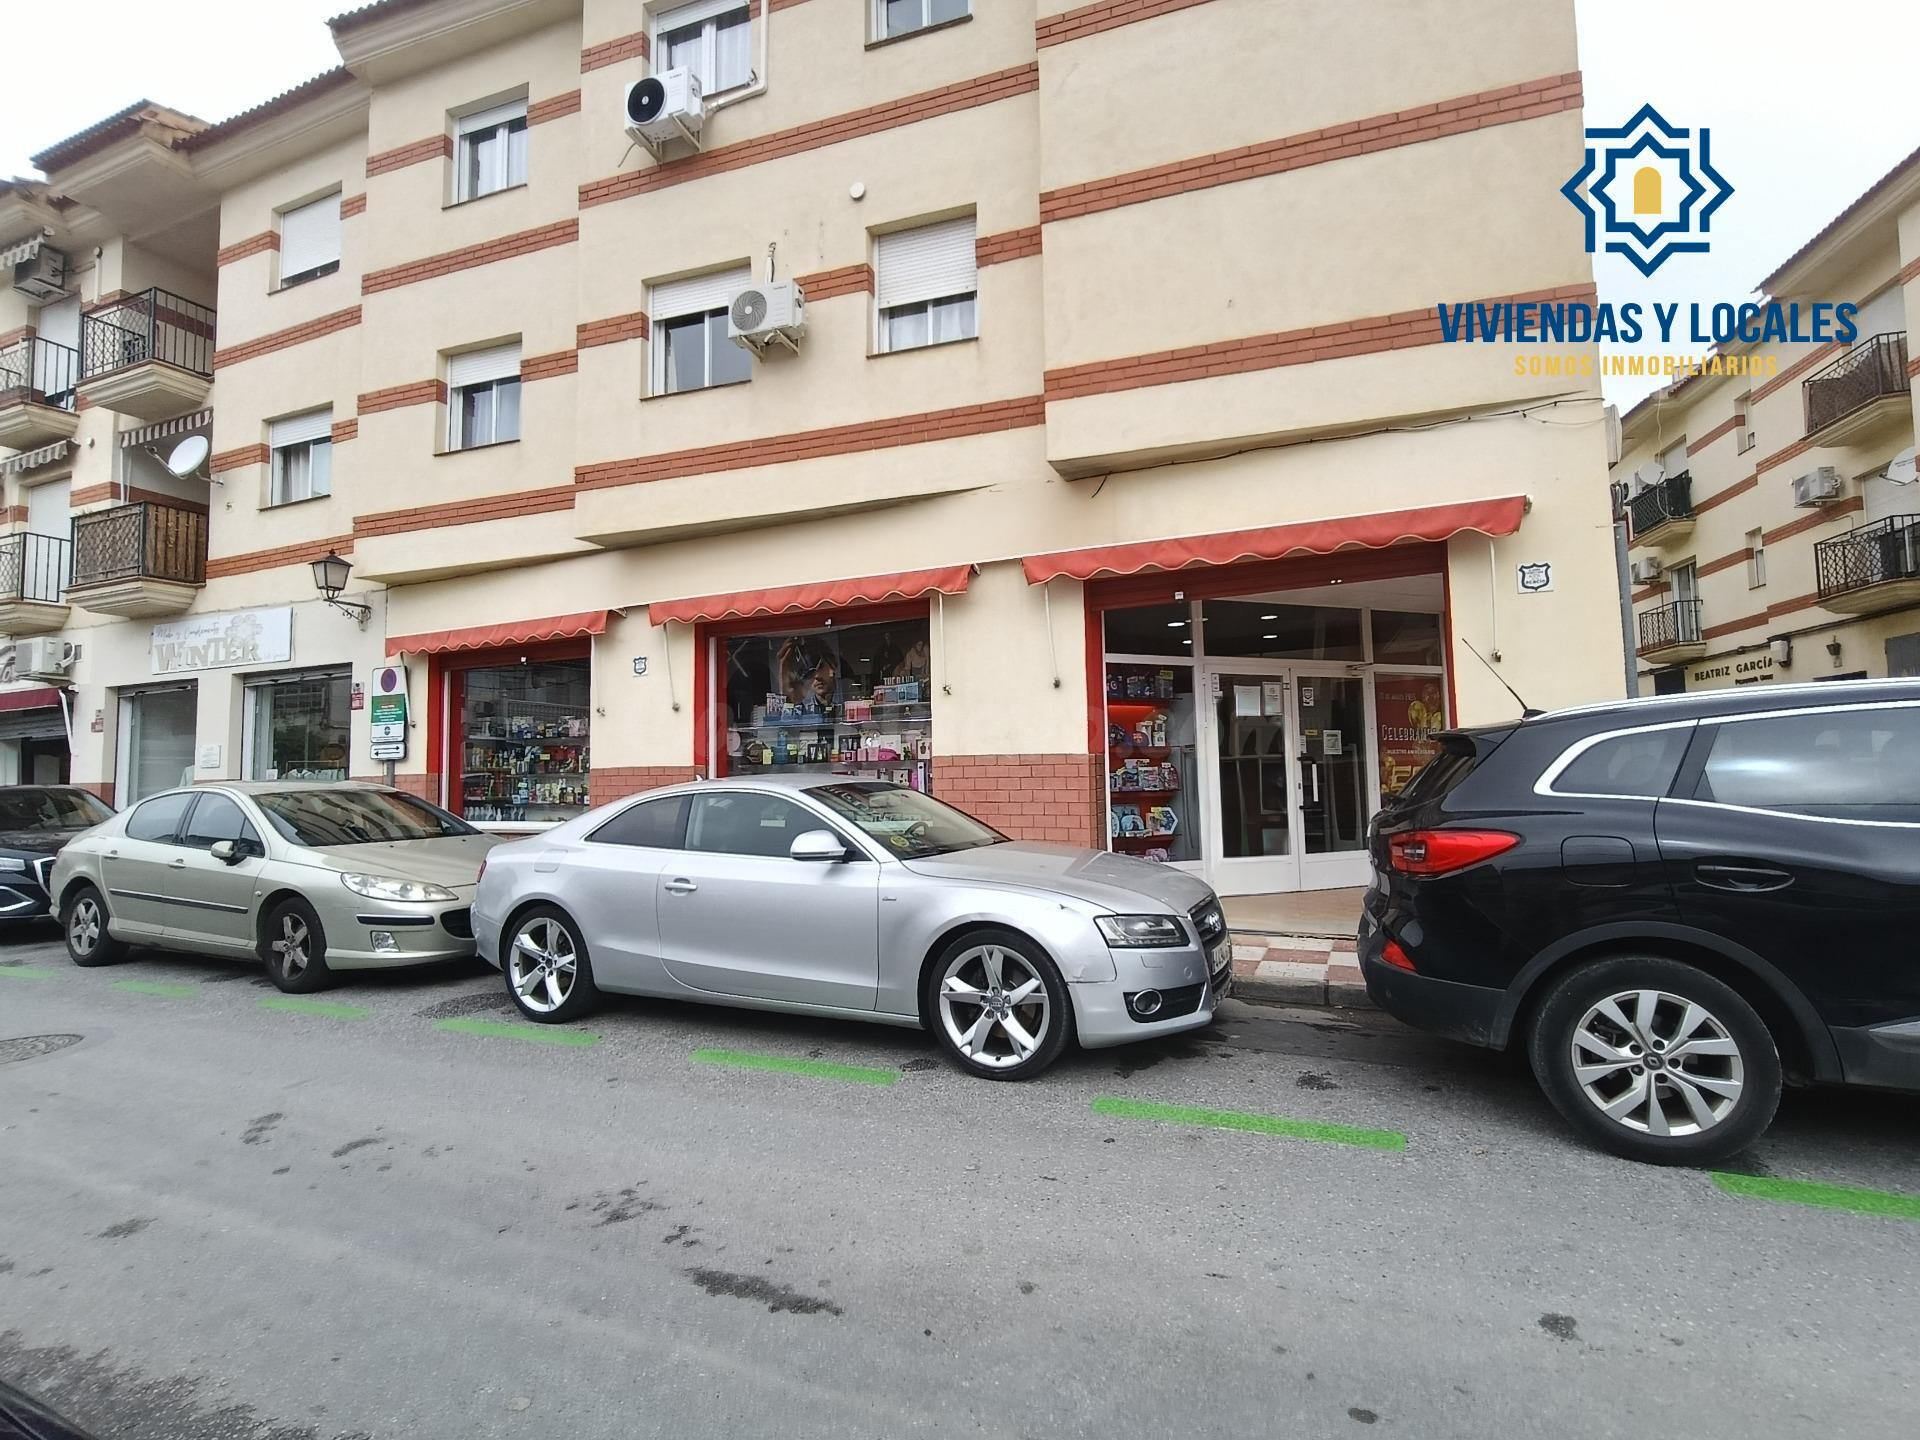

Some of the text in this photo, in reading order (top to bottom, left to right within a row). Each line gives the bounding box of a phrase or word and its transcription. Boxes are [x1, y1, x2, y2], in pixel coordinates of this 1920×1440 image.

[154, 637, 260, 672] WINTER
[1694, 666, 1731, 681] BEATRIZ
[1736, 656, 1773, 673] GARCÍA
